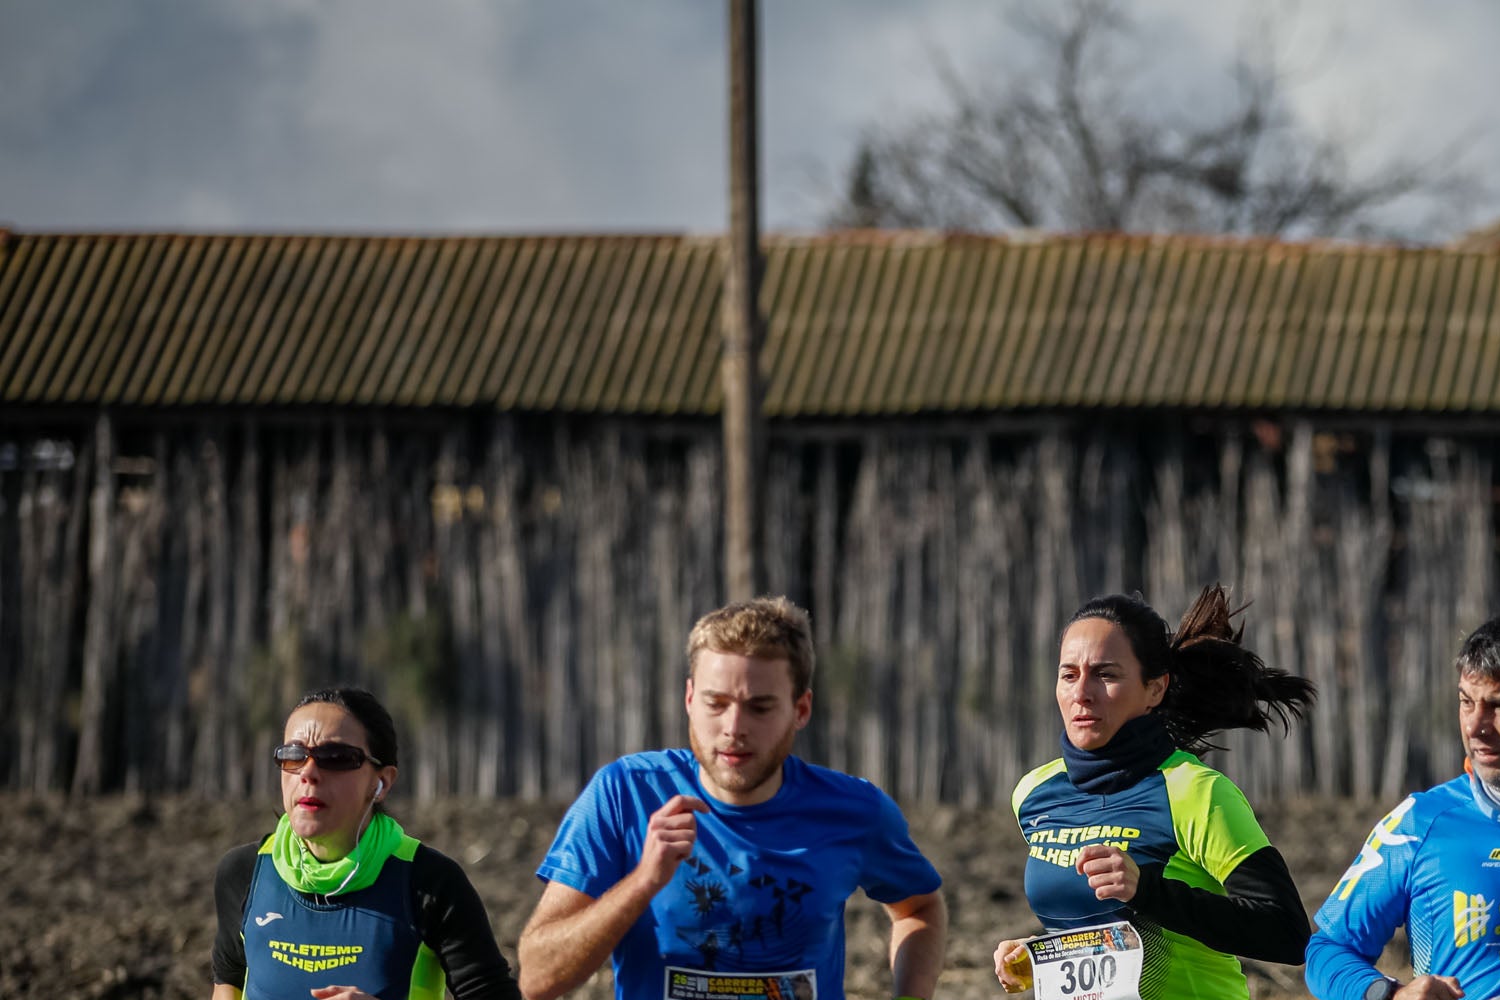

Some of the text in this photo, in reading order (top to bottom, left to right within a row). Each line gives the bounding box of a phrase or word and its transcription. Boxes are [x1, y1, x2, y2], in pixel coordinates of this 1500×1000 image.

[1029, 825, 1141, 844] ATLETISMO
[1061, 931, 1101, 943] CARRERA
[269, 940, 363, 957] ATLETISMO
[1063, 939, 1102, 950] POPULAR
[272, 951, 357, 973] ALHENDÍN
[1060, 955, 1117, 995] 300
[708, 978, 765, 987] CARRERA
[708, 986, 764, 994] POPULAR
